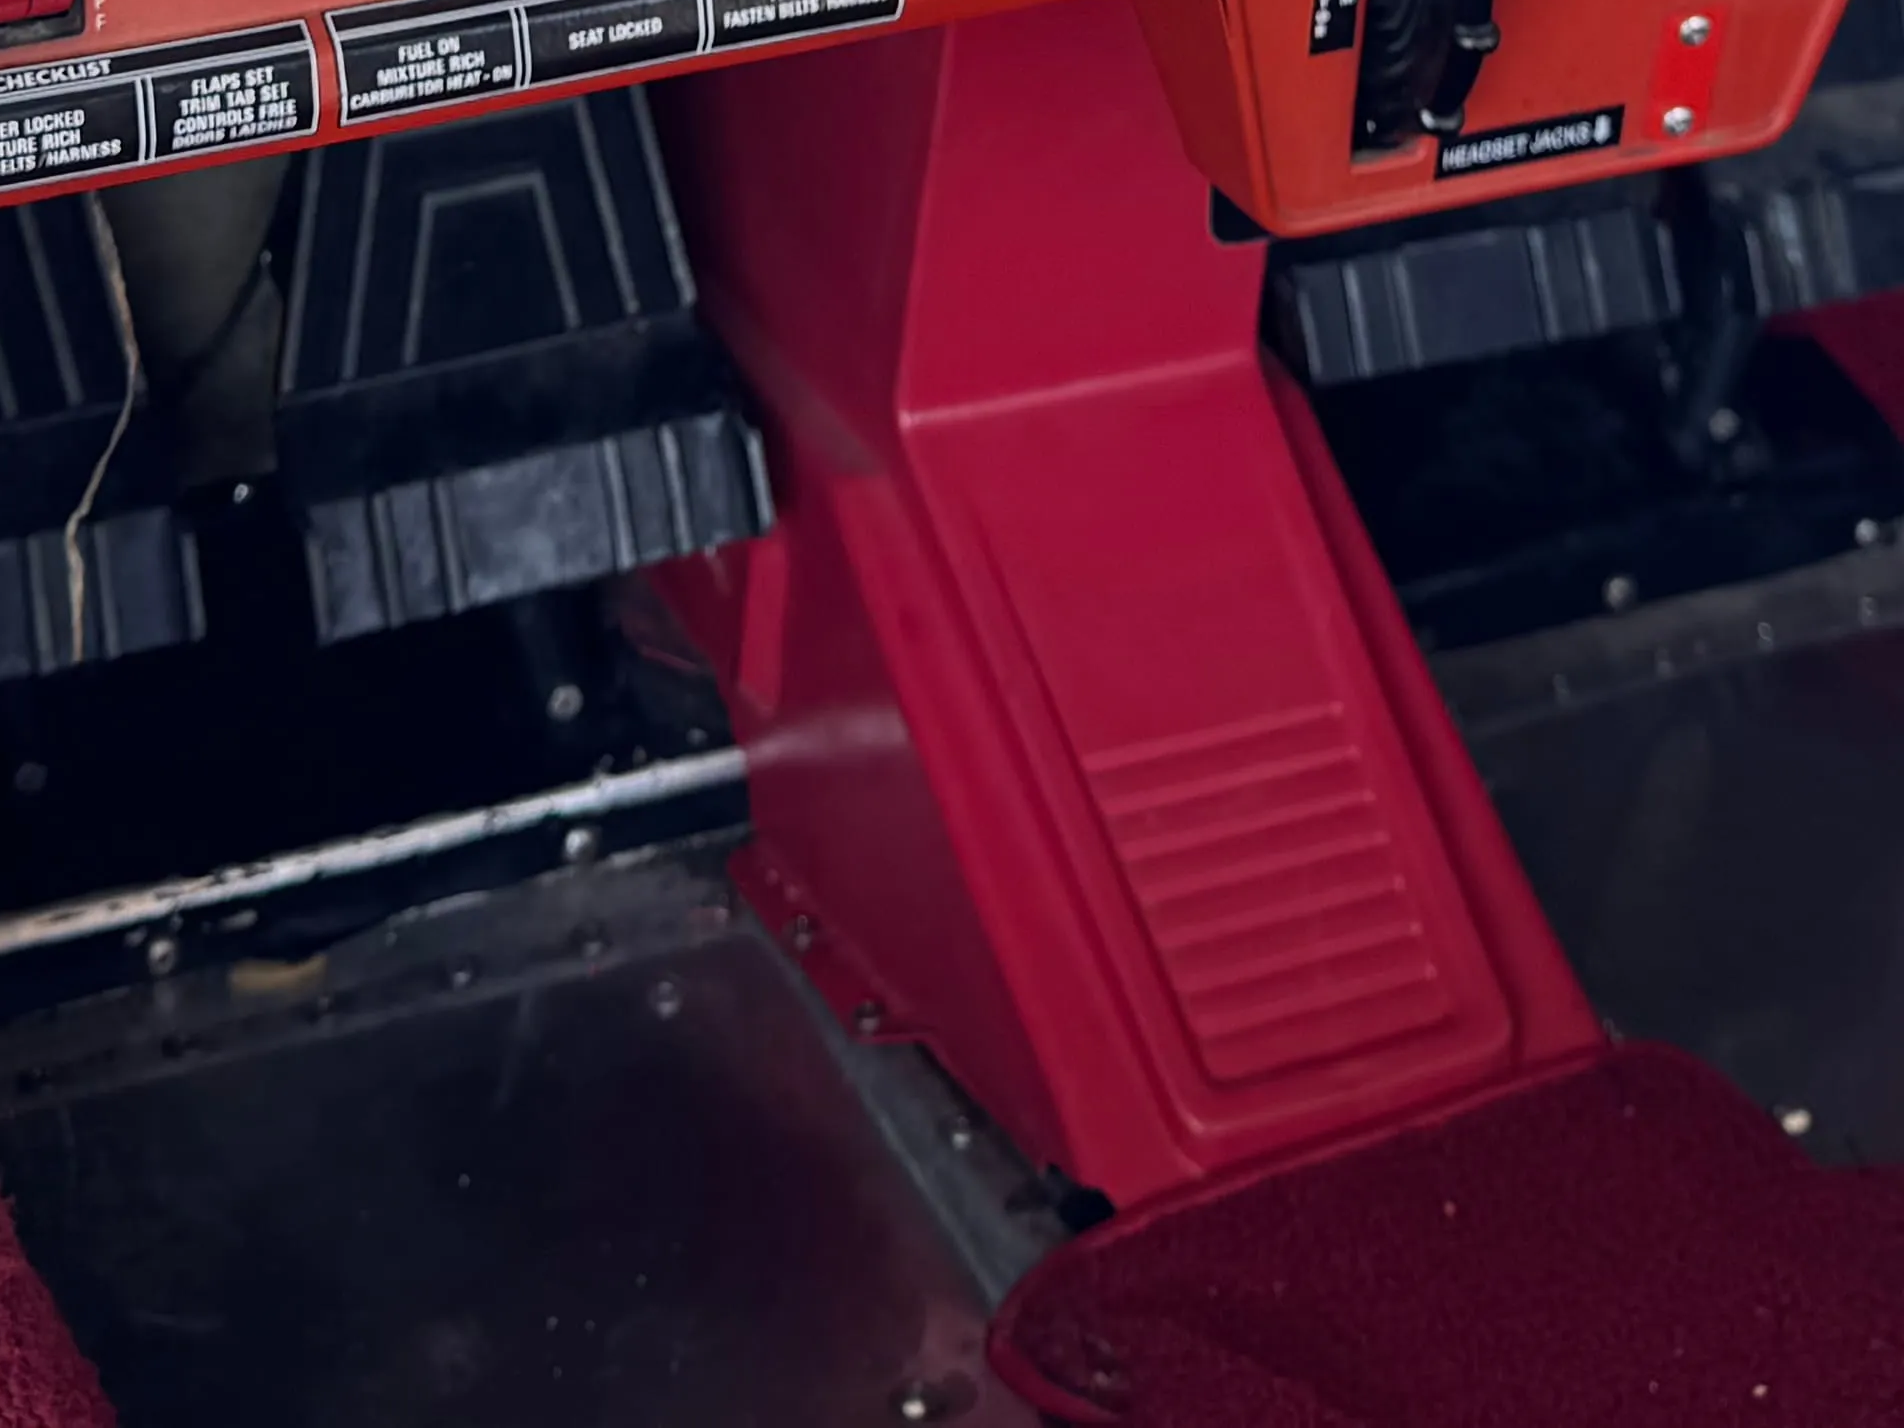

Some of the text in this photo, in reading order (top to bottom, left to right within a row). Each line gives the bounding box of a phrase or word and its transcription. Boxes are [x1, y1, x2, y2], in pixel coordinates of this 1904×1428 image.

[569, 16, 664, 51] SEAT LOCKED
[724, 5, 776, 29] FASTEN
[398, 36, 461, 64] FUEL ON
[191, 65, 275, 96] FLAPS SET
[377, 51, 486, 86] MIXTURE RICH
[179, 81, 289, 116] TRIM TAB SET
[349, 79, 444, 111] CARBURETOR
[446, 72, 481, 92] HEAT
[23, 109, 86, 136] LOCKED
[173, 99, 298, 136] CONTROLS FREE
[41, 128, 81, 152] RICH
[171, 127, 225, 151] DOORS
[1442, 121, 1593, 172] HEADSET JACKS
